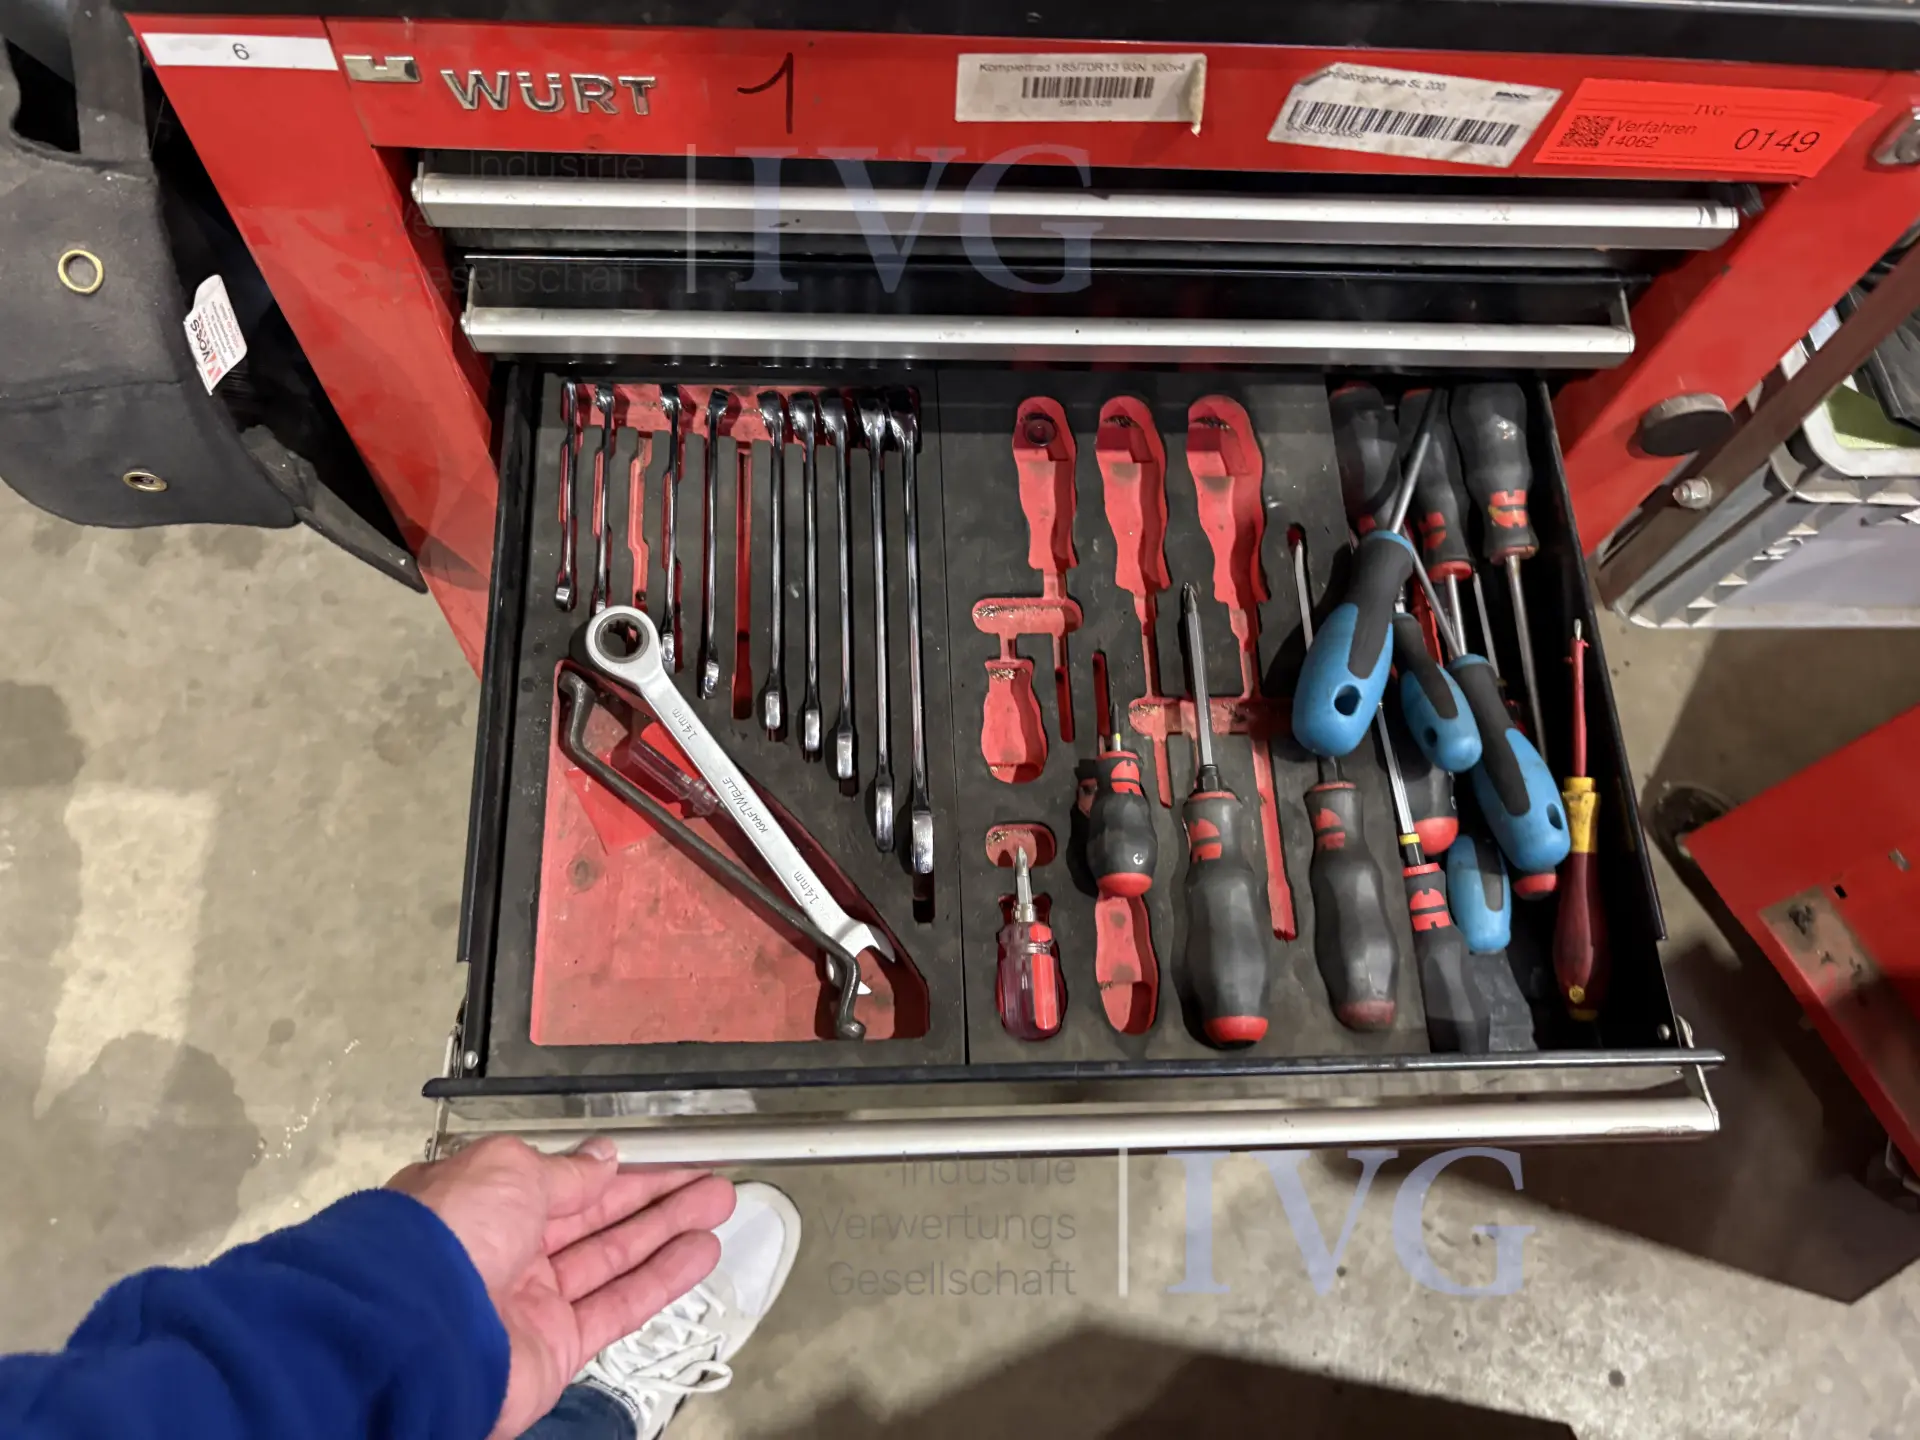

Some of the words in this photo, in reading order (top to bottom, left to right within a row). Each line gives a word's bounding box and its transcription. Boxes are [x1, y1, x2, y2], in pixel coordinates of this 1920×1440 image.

[232, 42, 250, 61] 6
[440, 69, 656, 115] WÜRT
[737, 52, 794, 134] 1
[1693, 104, 1729, 117] IVG
[1604, 135, 1660, 149] 14062
[1615, 119, 1698, 136] Verfahren
[1734, 127, 1821, 154] 0149
[190, 319, 211, 364] VOSS
[671, 708, 699, 740] 14mm
[722, 776, 769, 834] KRAFTWELLE
[793, 871, 820, 904] 14mm
